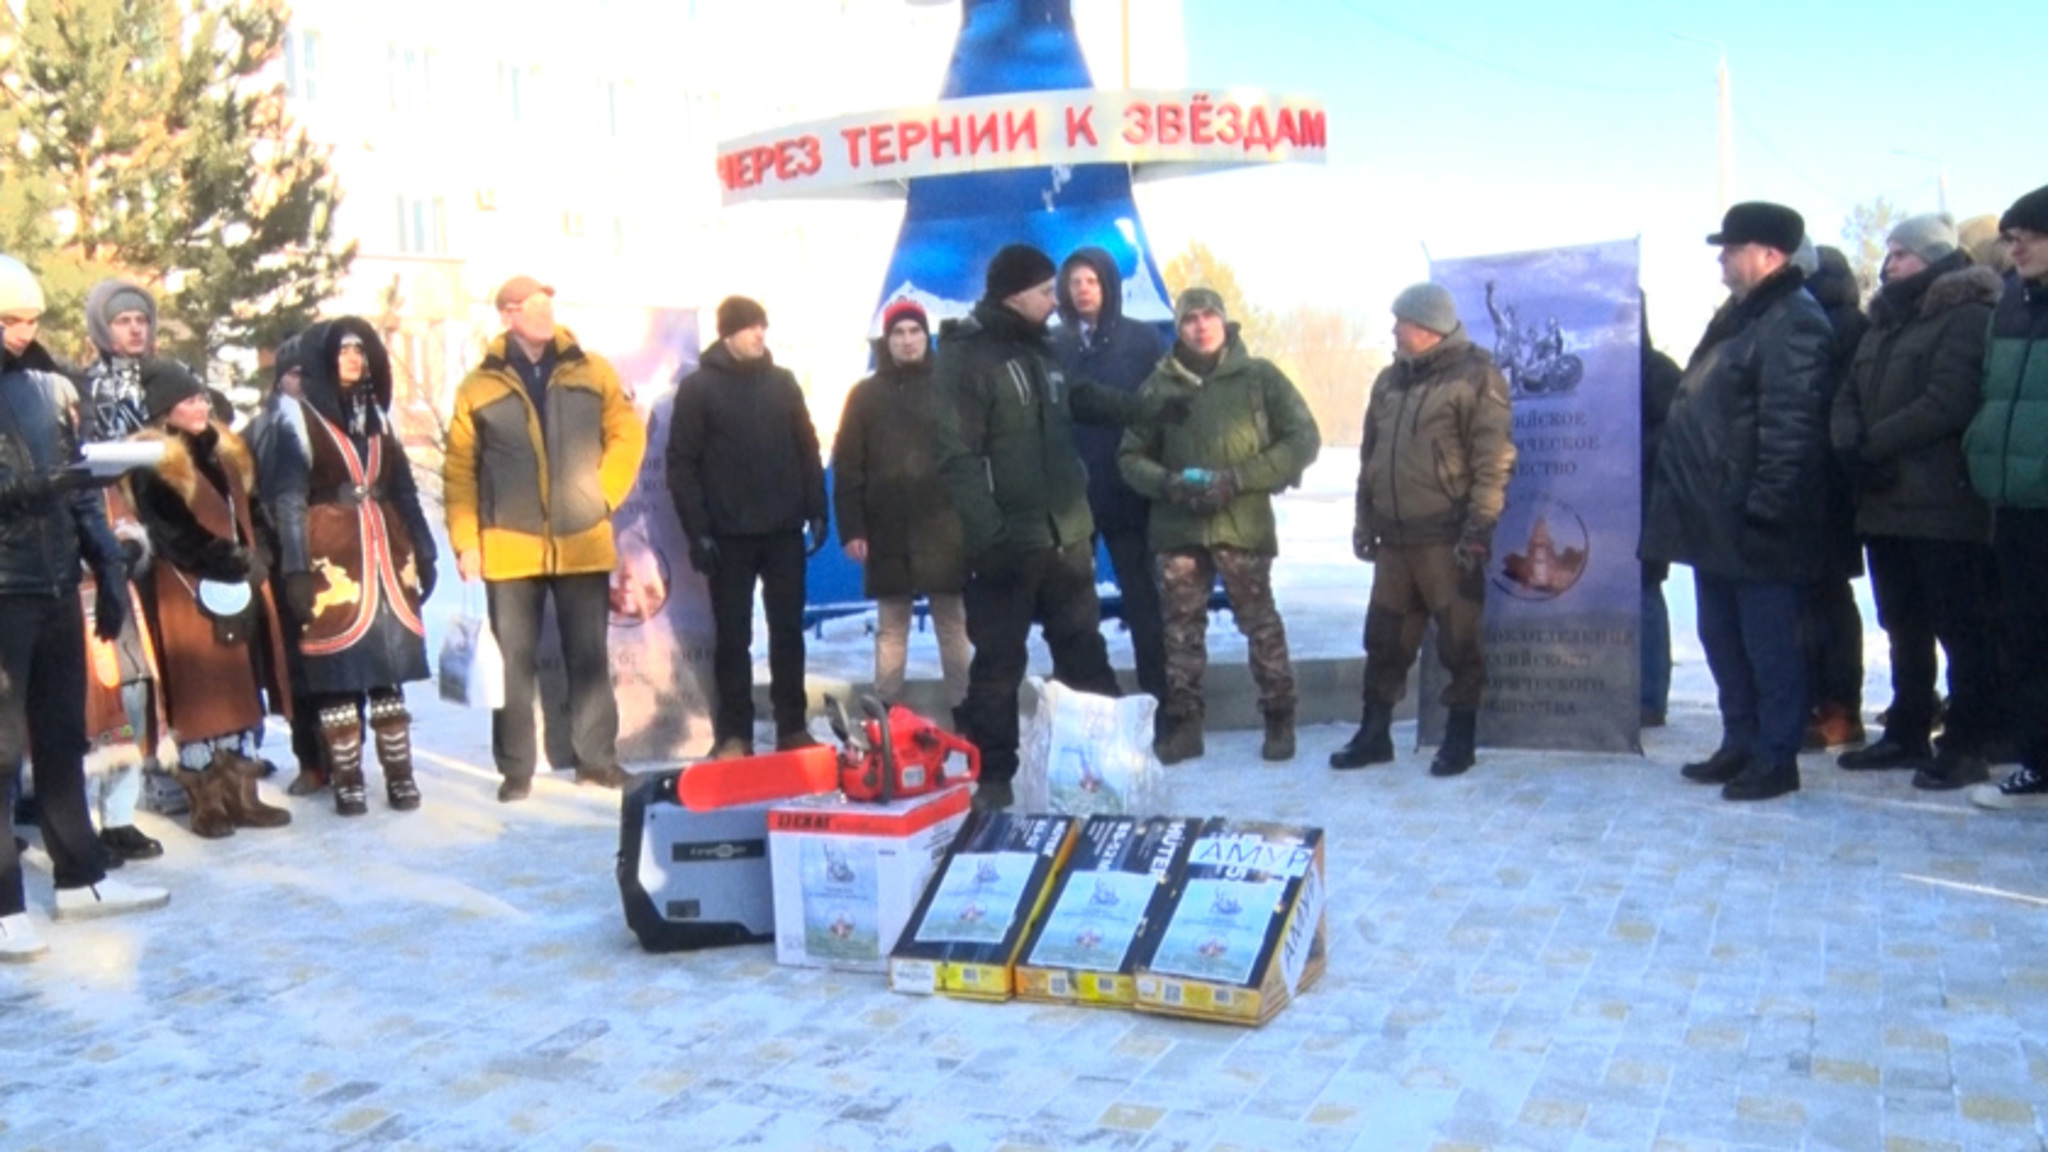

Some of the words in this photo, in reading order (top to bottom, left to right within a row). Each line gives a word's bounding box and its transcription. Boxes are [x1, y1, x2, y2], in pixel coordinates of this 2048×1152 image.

[840, 108, 1038, 168] ТЕРНИИ
[1065, 105, 1098, 148] К
[1122, 93, 1326, 152] ЗВЁЗДАМ
[1516, 436, 1600, 453] ИЧЕСКОЕ
[1517, 461, 1578, 477] ЕСТВО
[1198, 841, 1311, 870] АМУР
